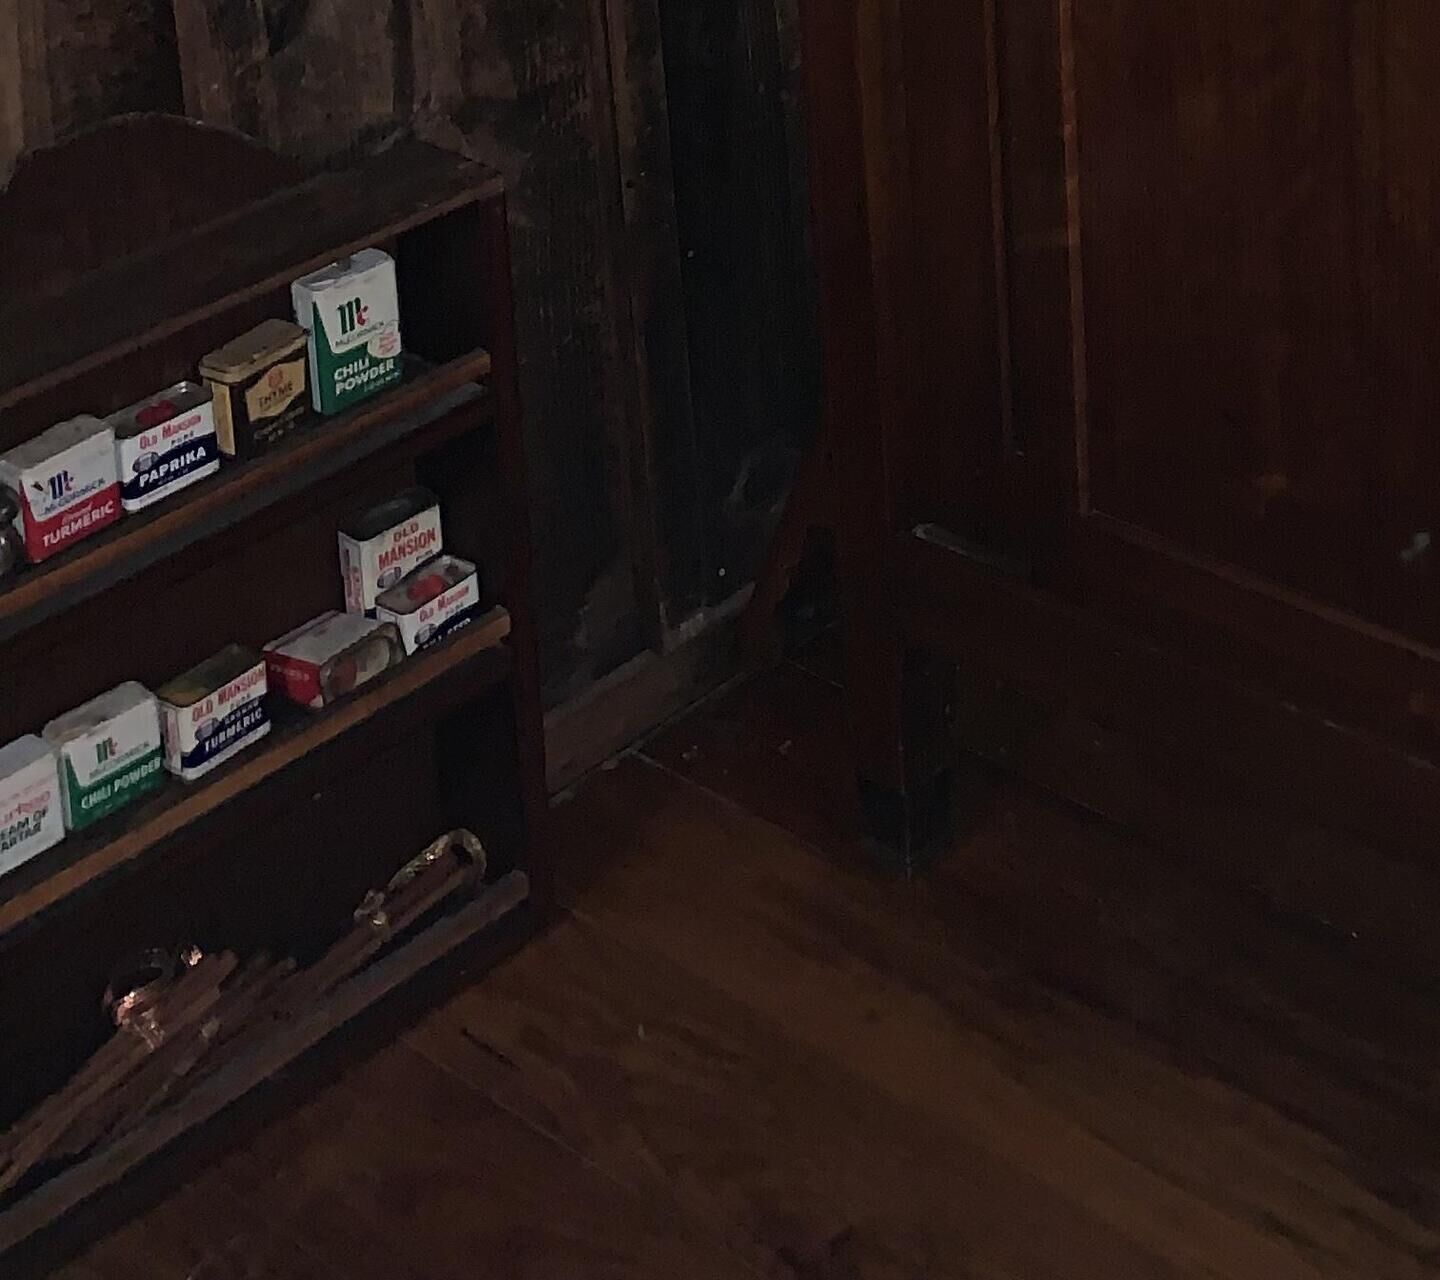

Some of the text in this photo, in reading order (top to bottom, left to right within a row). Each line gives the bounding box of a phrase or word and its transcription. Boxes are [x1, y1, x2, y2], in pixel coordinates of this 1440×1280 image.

[333, 357, 370, 382] CHILI
[335, 358, 395, 396] POWDER
[258, 382, 293, 408] THYME
[139, 434, 158, 450] OLD
[138, 446, 207, 488] PAPRIKA
[42, 499, 115, 548] TURMERIC
[392, 521, 419, 543] OLD
[378, 527, 437, 570] MANSION
[192, 703, 214, 722] OLD
[217, 667, 266, 706] MANSION
[204, 709, 262, 754] TURMERIC
[80, 788, 112, 810] CHILI
[113, 756, 162, 794] POWDER
